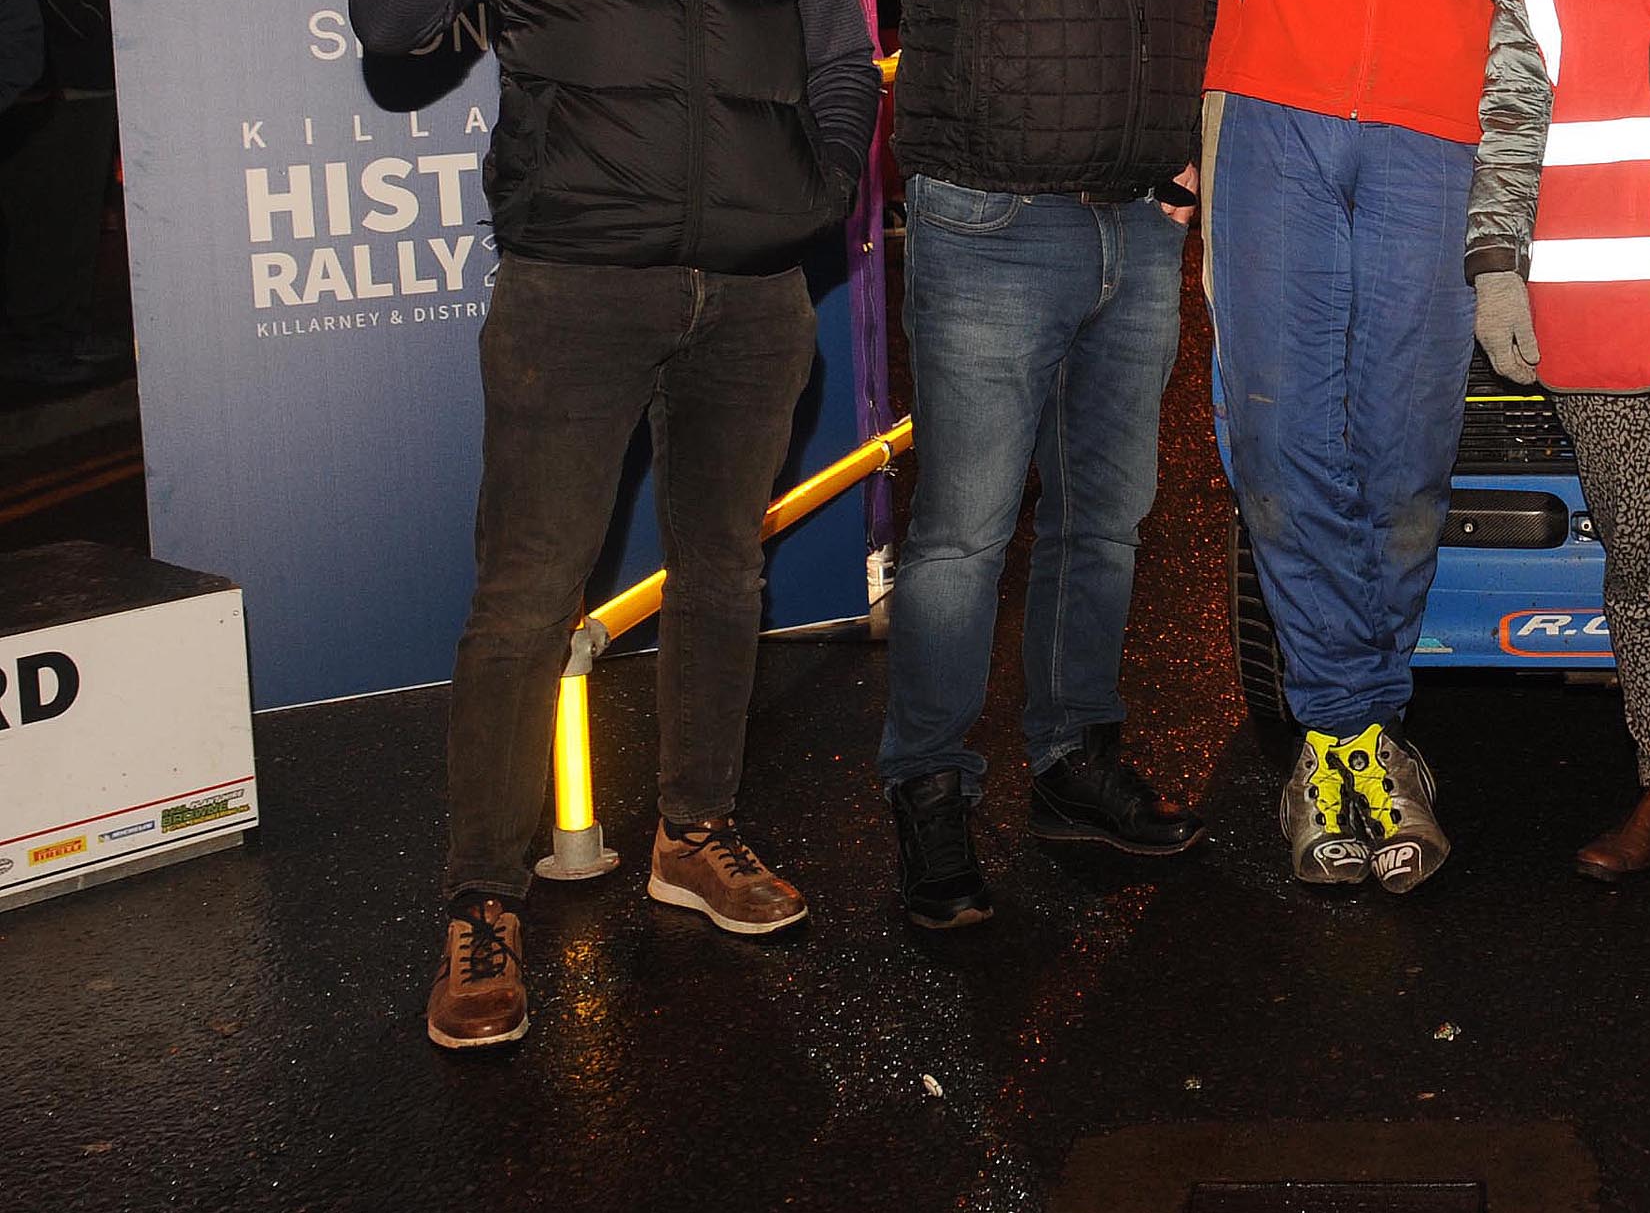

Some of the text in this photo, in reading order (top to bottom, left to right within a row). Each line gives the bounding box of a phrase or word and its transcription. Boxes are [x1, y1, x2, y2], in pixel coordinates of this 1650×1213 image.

[250, 234, 476, 310] RALLY
[256, 312, 381, 339] KILLARNEY
[390, 310, 404, 325] &
